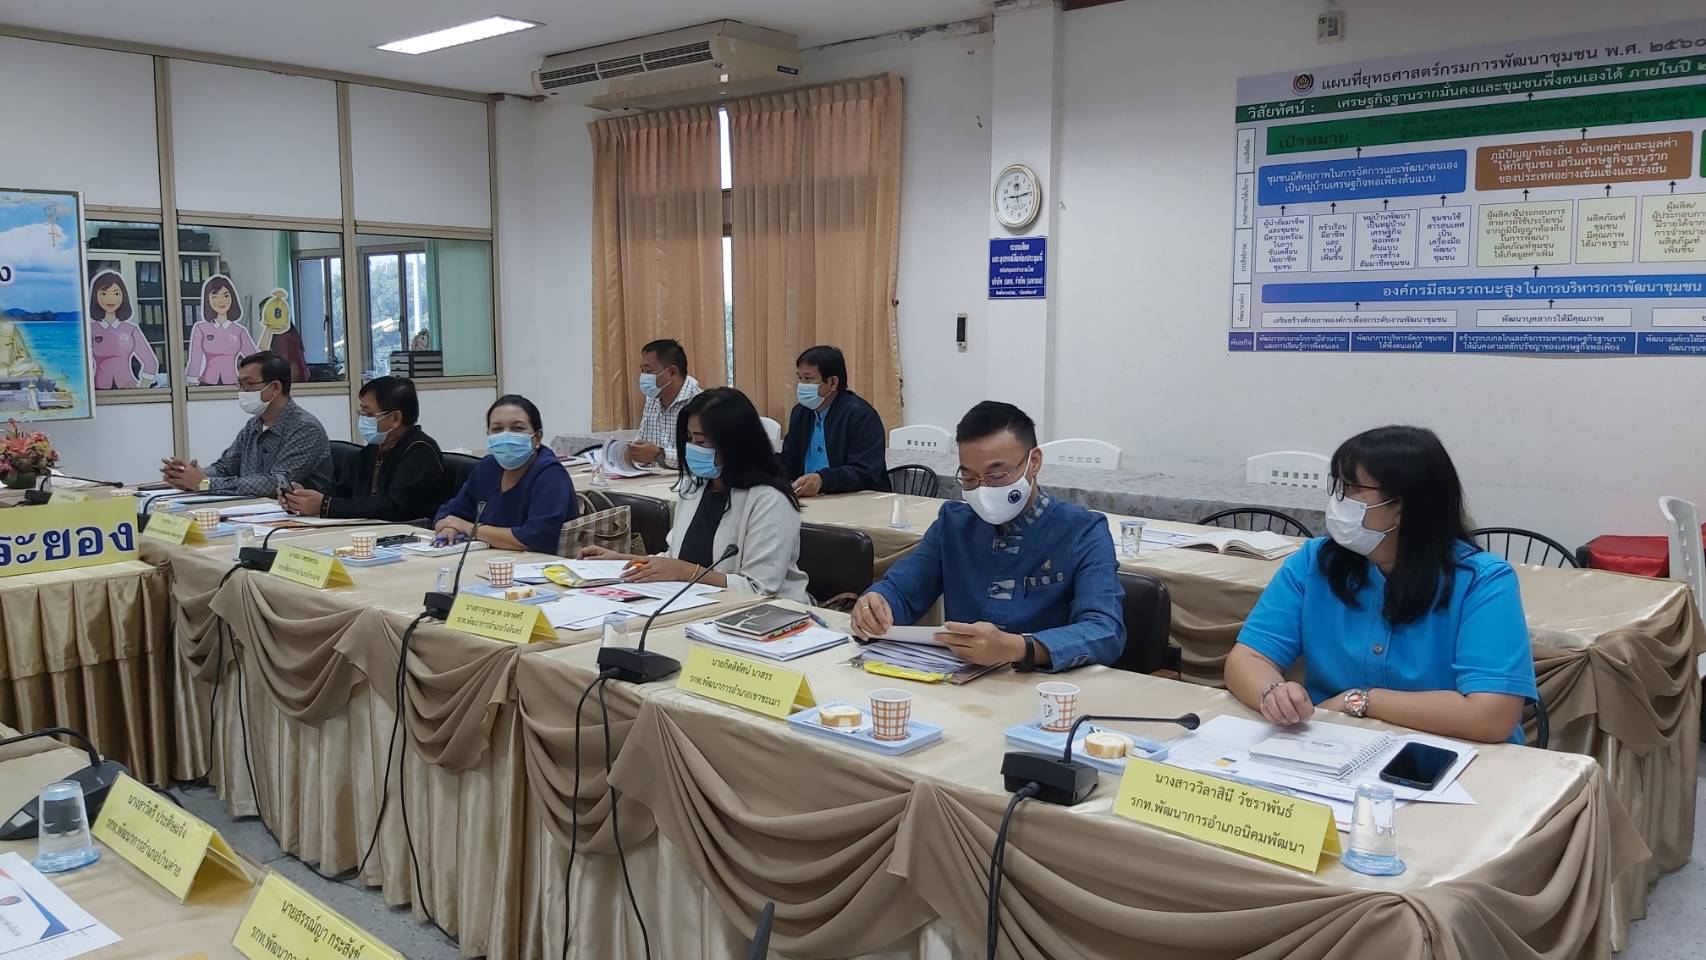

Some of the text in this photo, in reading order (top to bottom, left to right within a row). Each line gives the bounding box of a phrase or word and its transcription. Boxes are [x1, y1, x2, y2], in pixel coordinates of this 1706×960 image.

[1248, 101, 1306, 119] วิสัยทัศน์
[1628, 59, 1691, 78] ภายในปี
[1322, 48, 1598, 89] แผนที่ยุทธศาสตร์กรมการพัฒนาชุมชน
[1605, 43, 1641, 57] พ.ศ.
[1490, 142, 1572, 164] ภูมิปัญญาท้องถิ่น
[1155, 772, 1296, 819] นางสาววิลาสินี วัชราพันธ์
[1130, 796, 1305, 855] รกท.พัฒนาการอำเภอนิคมพัฒนา
